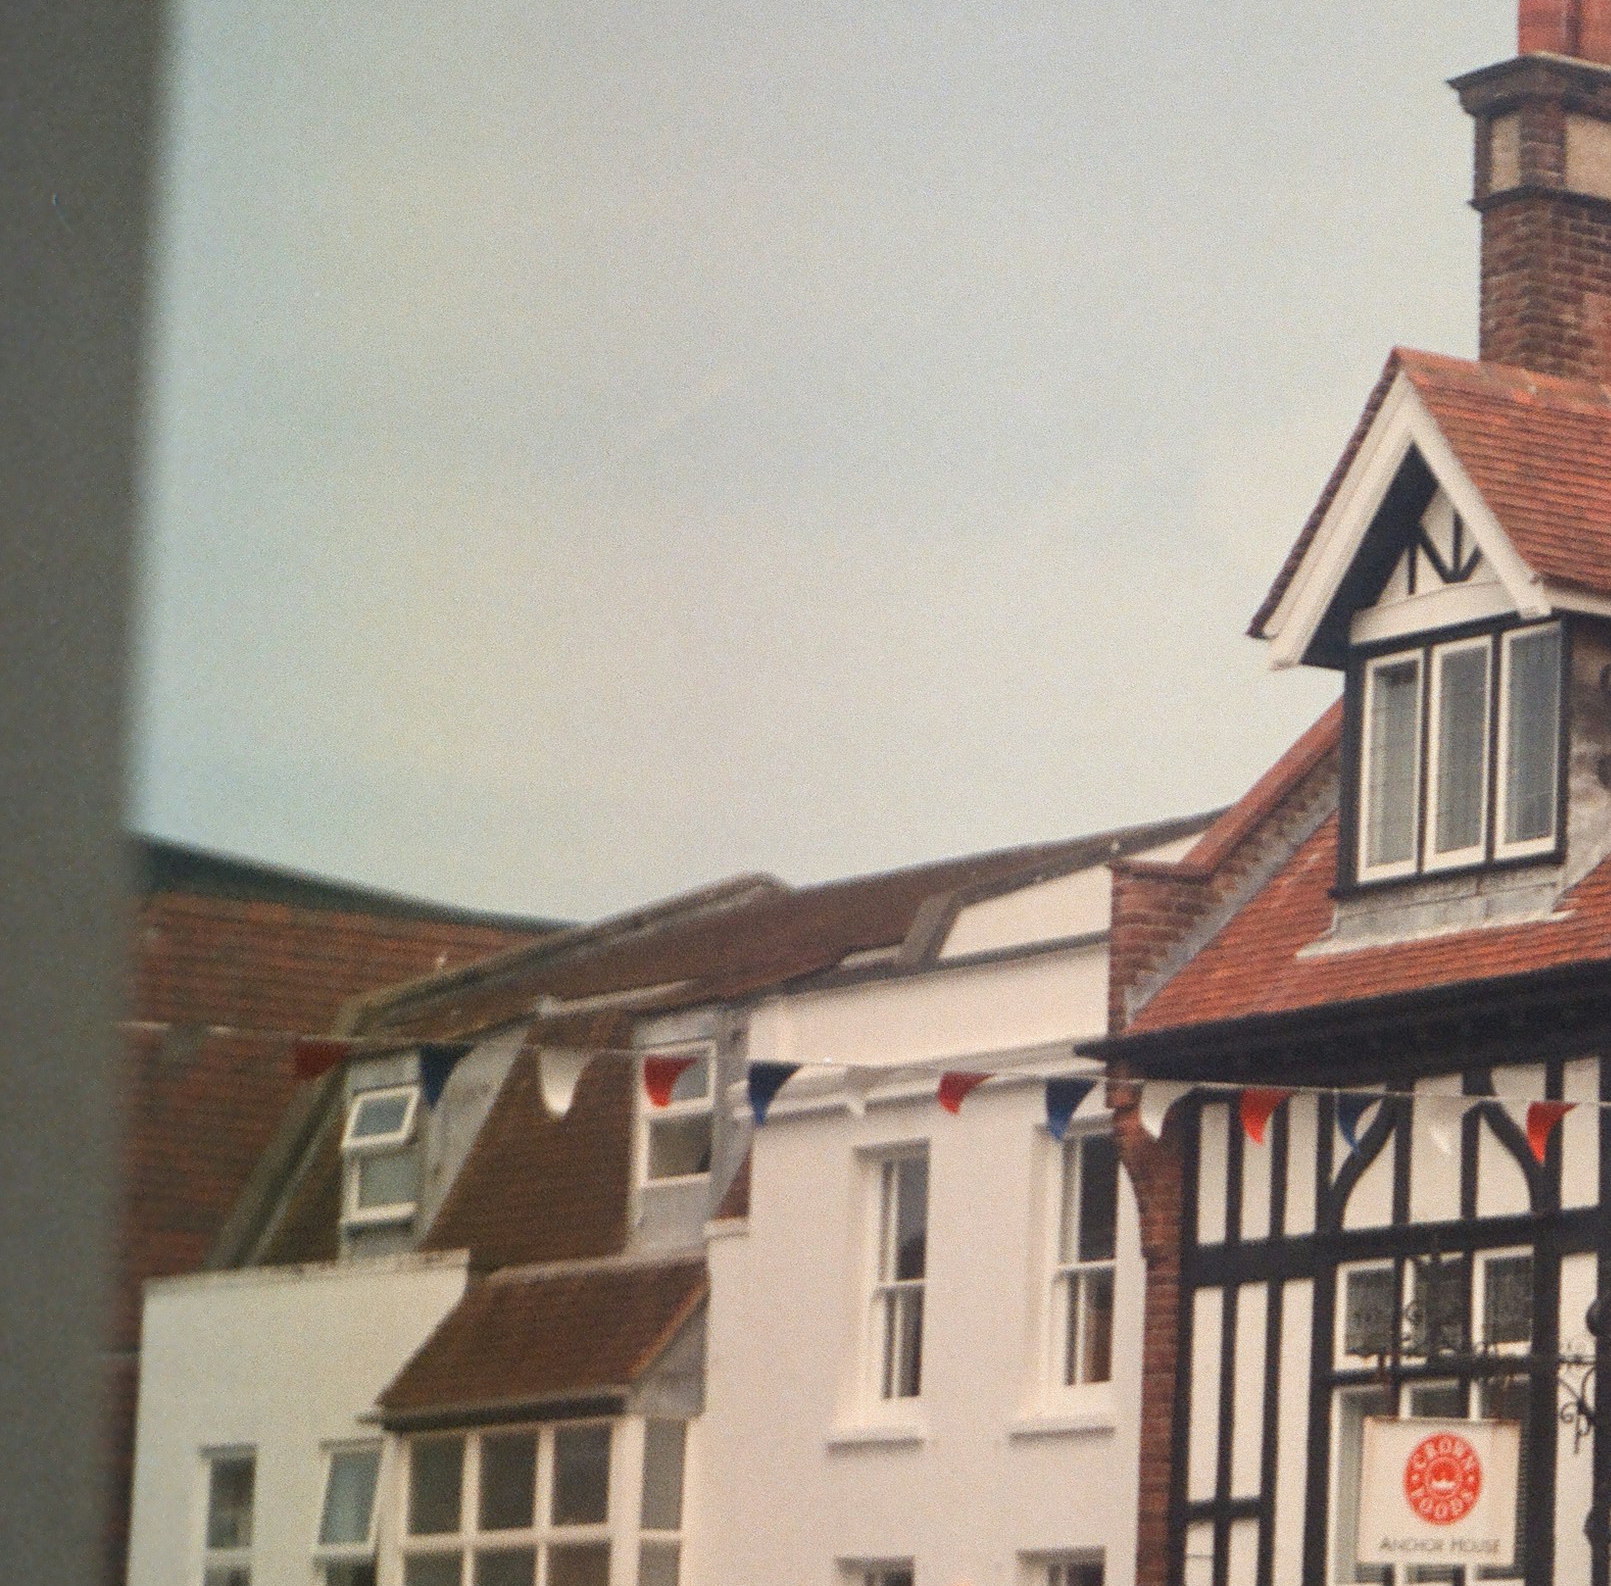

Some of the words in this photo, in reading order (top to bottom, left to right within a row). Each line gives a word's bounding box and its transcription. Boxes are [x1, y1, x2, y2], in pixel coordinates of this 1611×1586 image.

[1412, 1436, 1480, 1471] CROWN
[1378, 1535, 1445, 1553] ANCHOR
[1450, 1536, 1501, 1555] HOUSE
